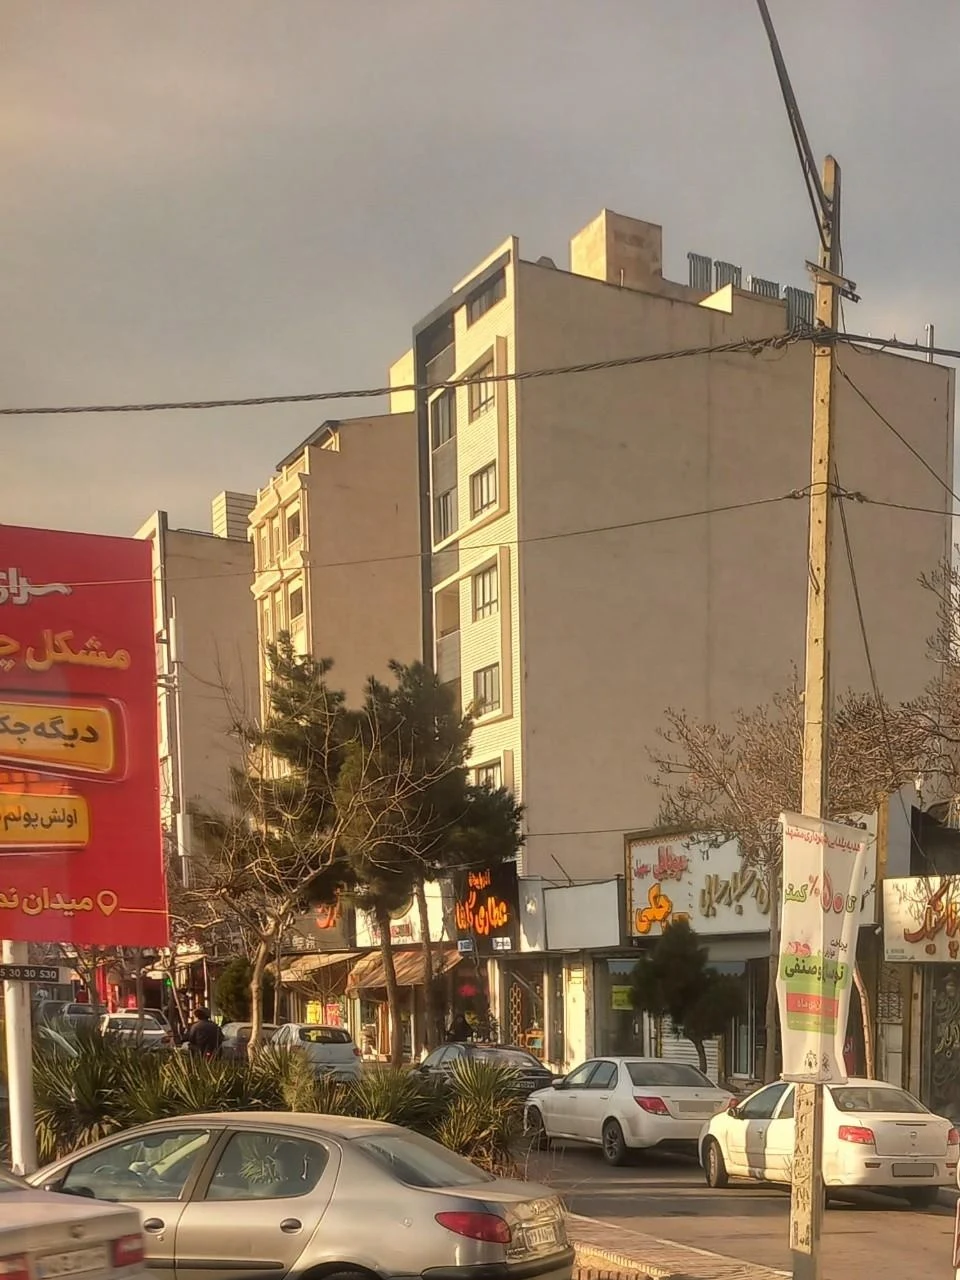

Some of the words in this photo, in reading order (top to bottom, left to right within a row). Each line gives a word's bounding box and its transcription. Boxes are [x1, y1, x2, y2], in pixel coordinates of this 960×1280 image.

[25, 628, 131, 671] مشکل
[33, 715, 99, 748] دیگه
[40, 808, 78, 829] اولش
[22, 887, 94, 917] میدان
[23, 969, 36, 978] 30
